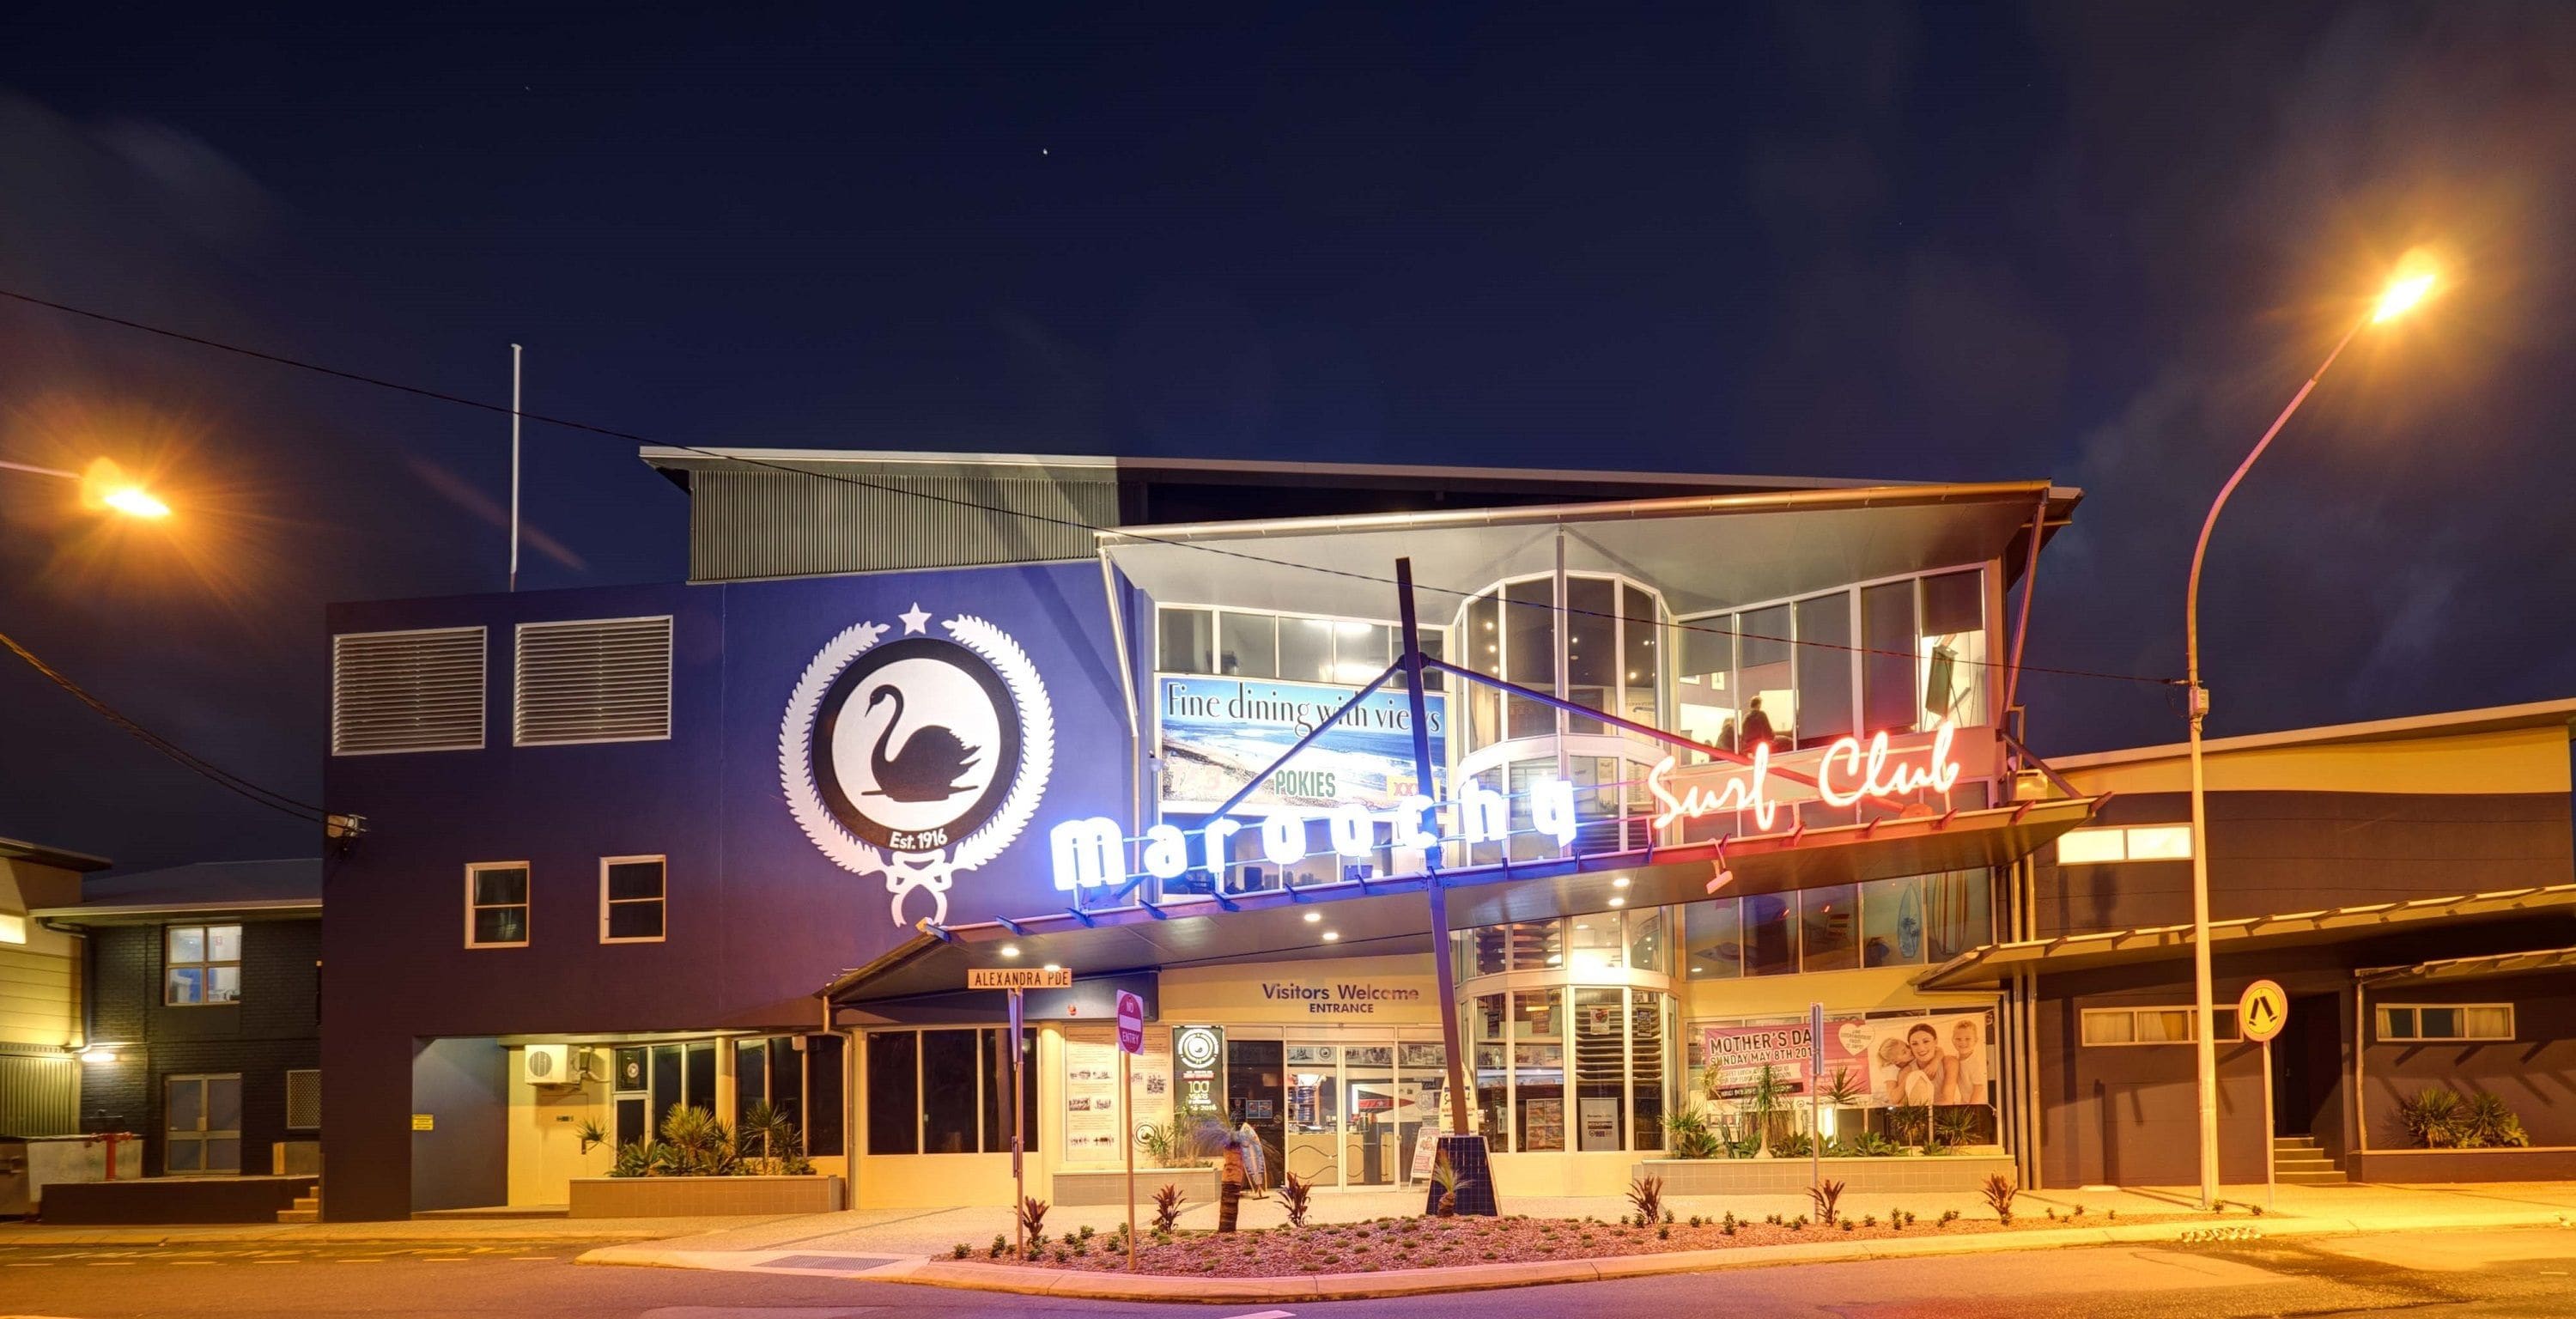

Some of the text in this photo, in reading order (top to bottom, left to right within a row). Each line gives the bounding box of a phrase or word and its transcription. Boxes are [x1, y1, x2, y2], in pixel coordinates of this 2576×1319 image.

[1167, 681, 1441, 738] Fine dining with vies
[1275, 769, 1336, 798] POKIES
[1647, 741, 1777, 831] Surf
[1818, 719, 1961, 808] Club
[917, 827, 948, 849] 1916
[975, 971, 1069, 987] ALEXANDRA PDE
[1262, 982, 1419, 1000] Visitors Welcome
[1126, 1001, 1134, 1013] NO
[1309, 1003, 1374, 1013] ENTRANCE
[1121, 1031, 1139, 1045] ENTRY
[1710, 1028, 1813, 1055] MOTHER'S DA
[1710, 1046, 1813, 1067] SUNDAY MAY 8TH 201
[1187, 1079, 1210, 1094] 100
